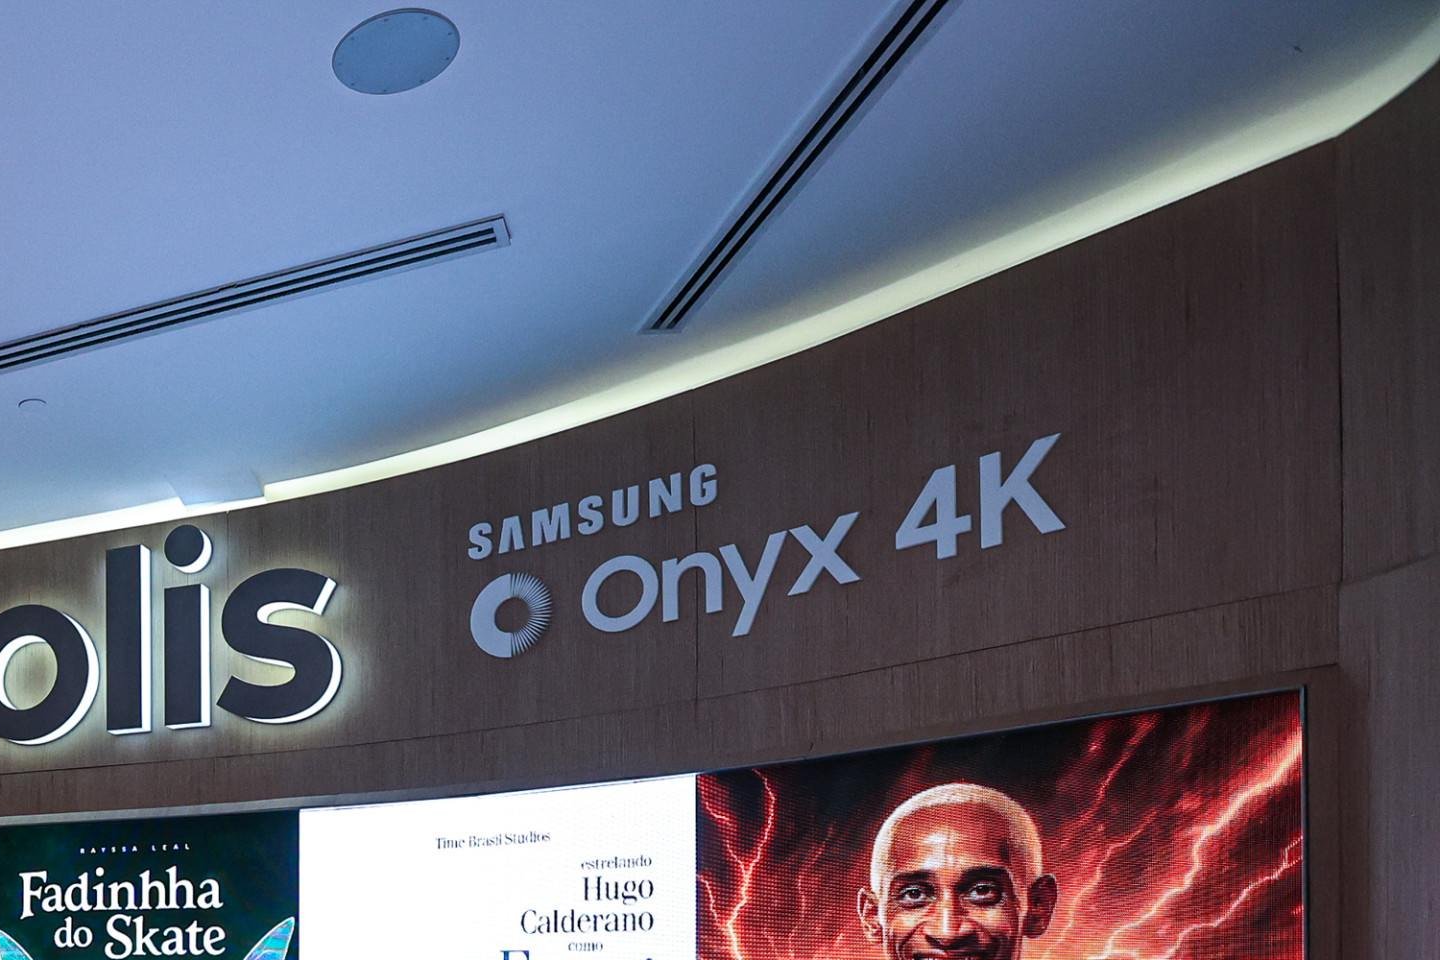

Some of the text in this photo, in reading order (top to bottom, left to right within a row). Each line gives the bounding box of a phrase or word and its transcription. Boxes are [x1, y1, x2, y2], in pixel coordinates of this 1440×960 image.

[895, 433, 1066, 559] 4K
[467, 463, 719, 560] SAMSUNG
[151, 843, 191, 852] LEAL
[435, 835, 465, 850] Time
[504, 830, 552, 846] Studios
[582, 876, 654, 906] Hugo
[520, 908, 654, 934] Calderano
[54, 914, 226, 960] do Skate
